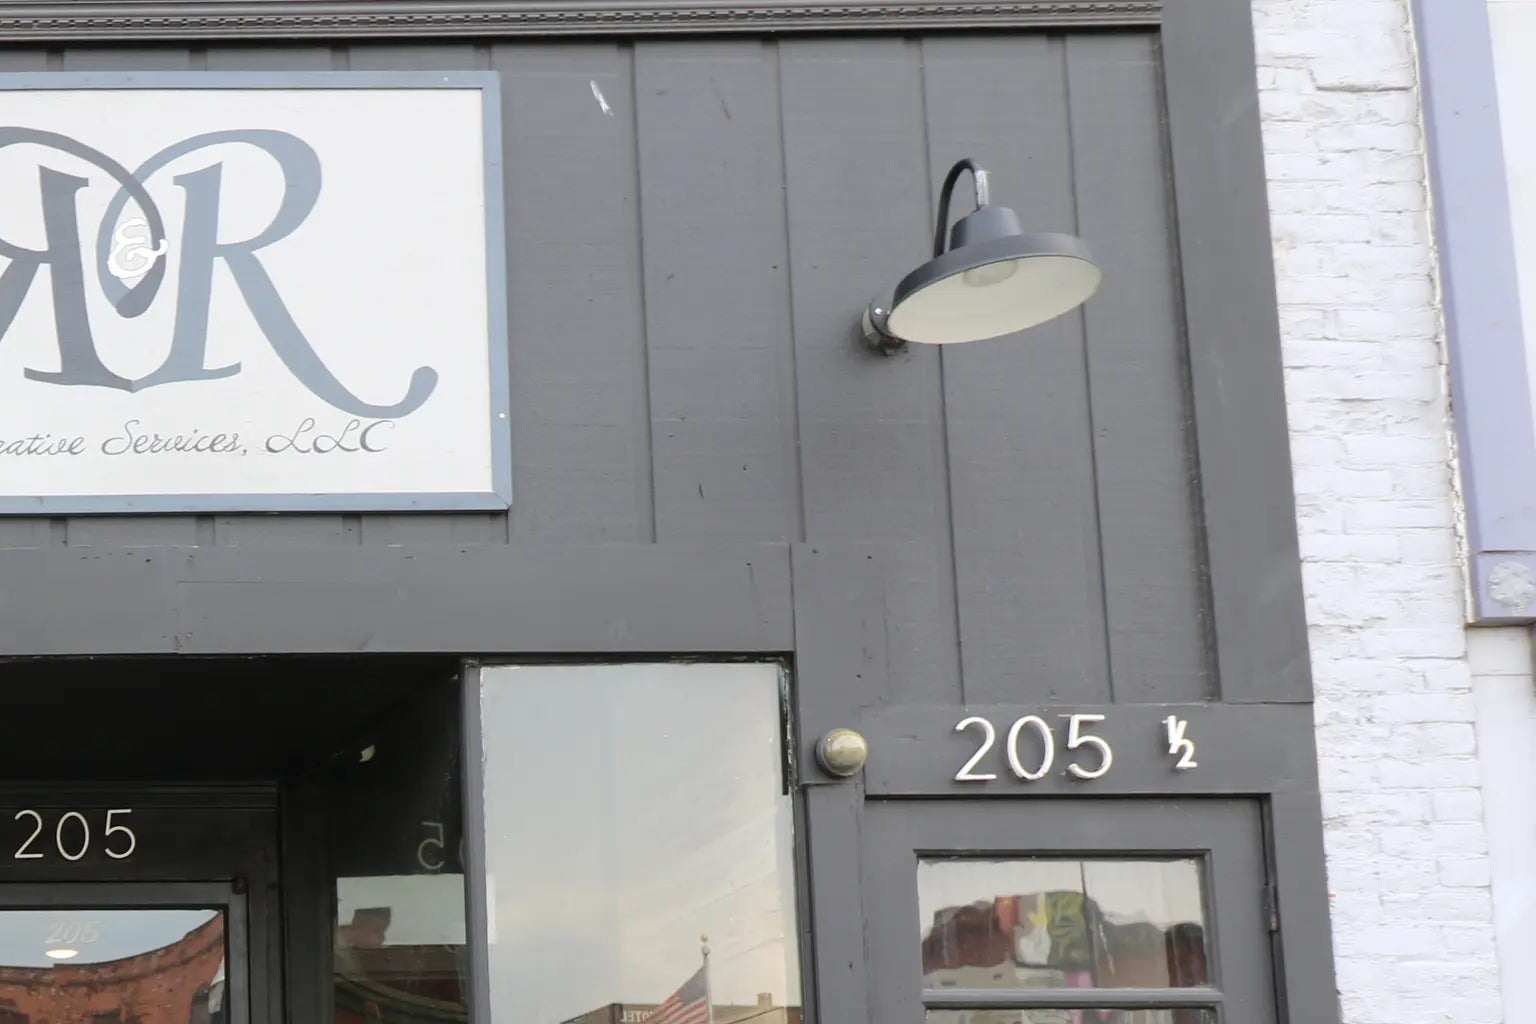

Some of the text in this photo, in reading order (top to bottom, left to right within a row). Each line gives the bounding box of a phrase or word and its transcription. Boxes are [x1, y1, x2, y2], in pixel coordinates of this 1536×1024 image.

[101, 420, 248, 458] Services,
[264, 418, 396, 455] LLC
[955, 714, 1113, 781] 205
[14, 809, 137, 861] 205
